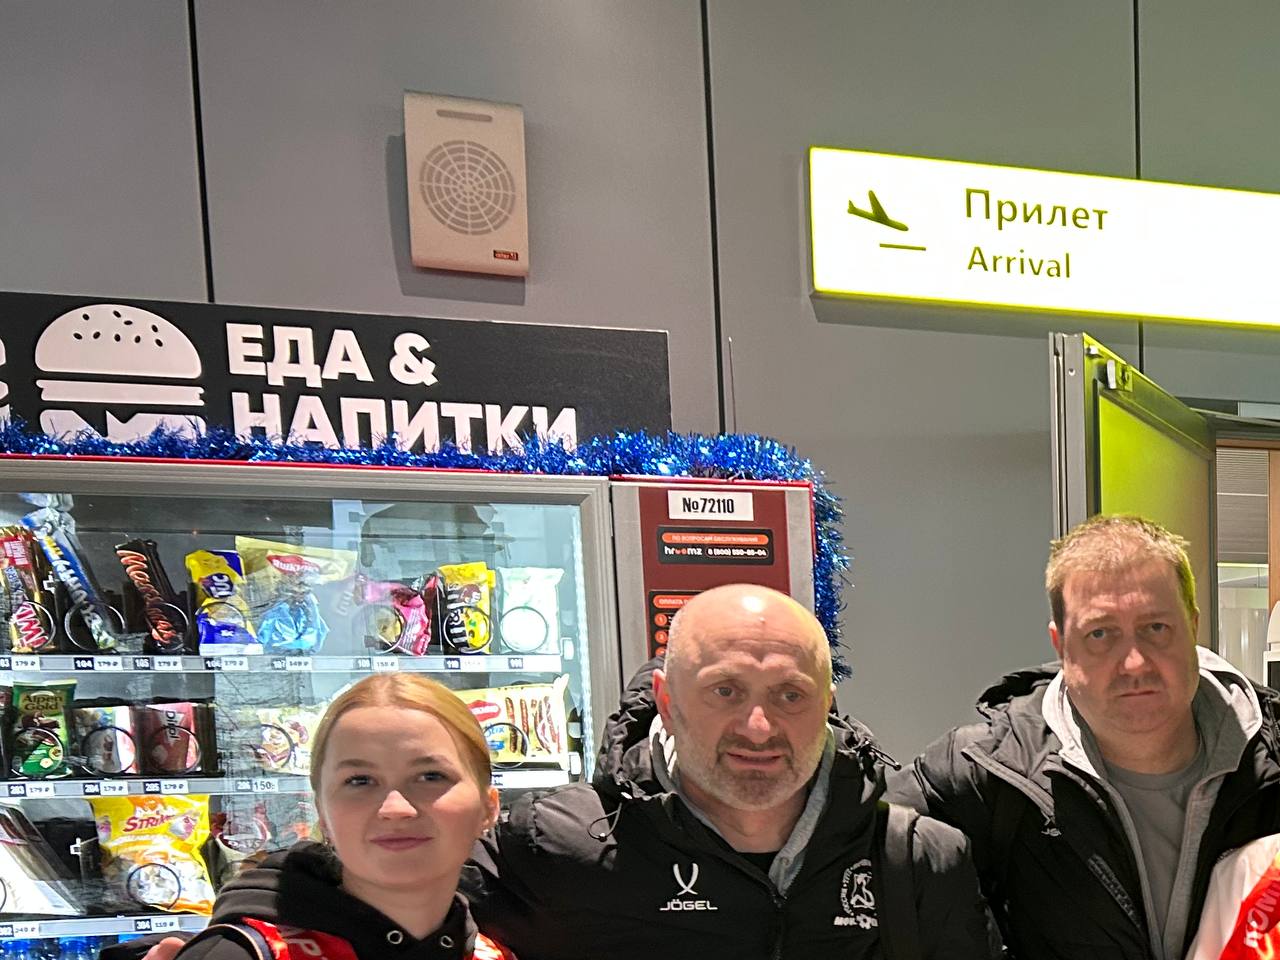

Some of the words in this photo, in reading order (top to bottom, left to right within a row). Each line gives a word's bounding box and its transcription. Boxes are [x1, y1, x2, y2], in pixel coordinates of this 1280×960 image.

[966, 188, 1108, 230] Прилет
[968, 246, 1070, 278] Arrival
[226, 322, 373, 388] ЕДА
[390, 332, 438, 386] &
[231, 392, 577, 454] НАПИТКИ
[659, 899, 718, 911] JÖGEL
